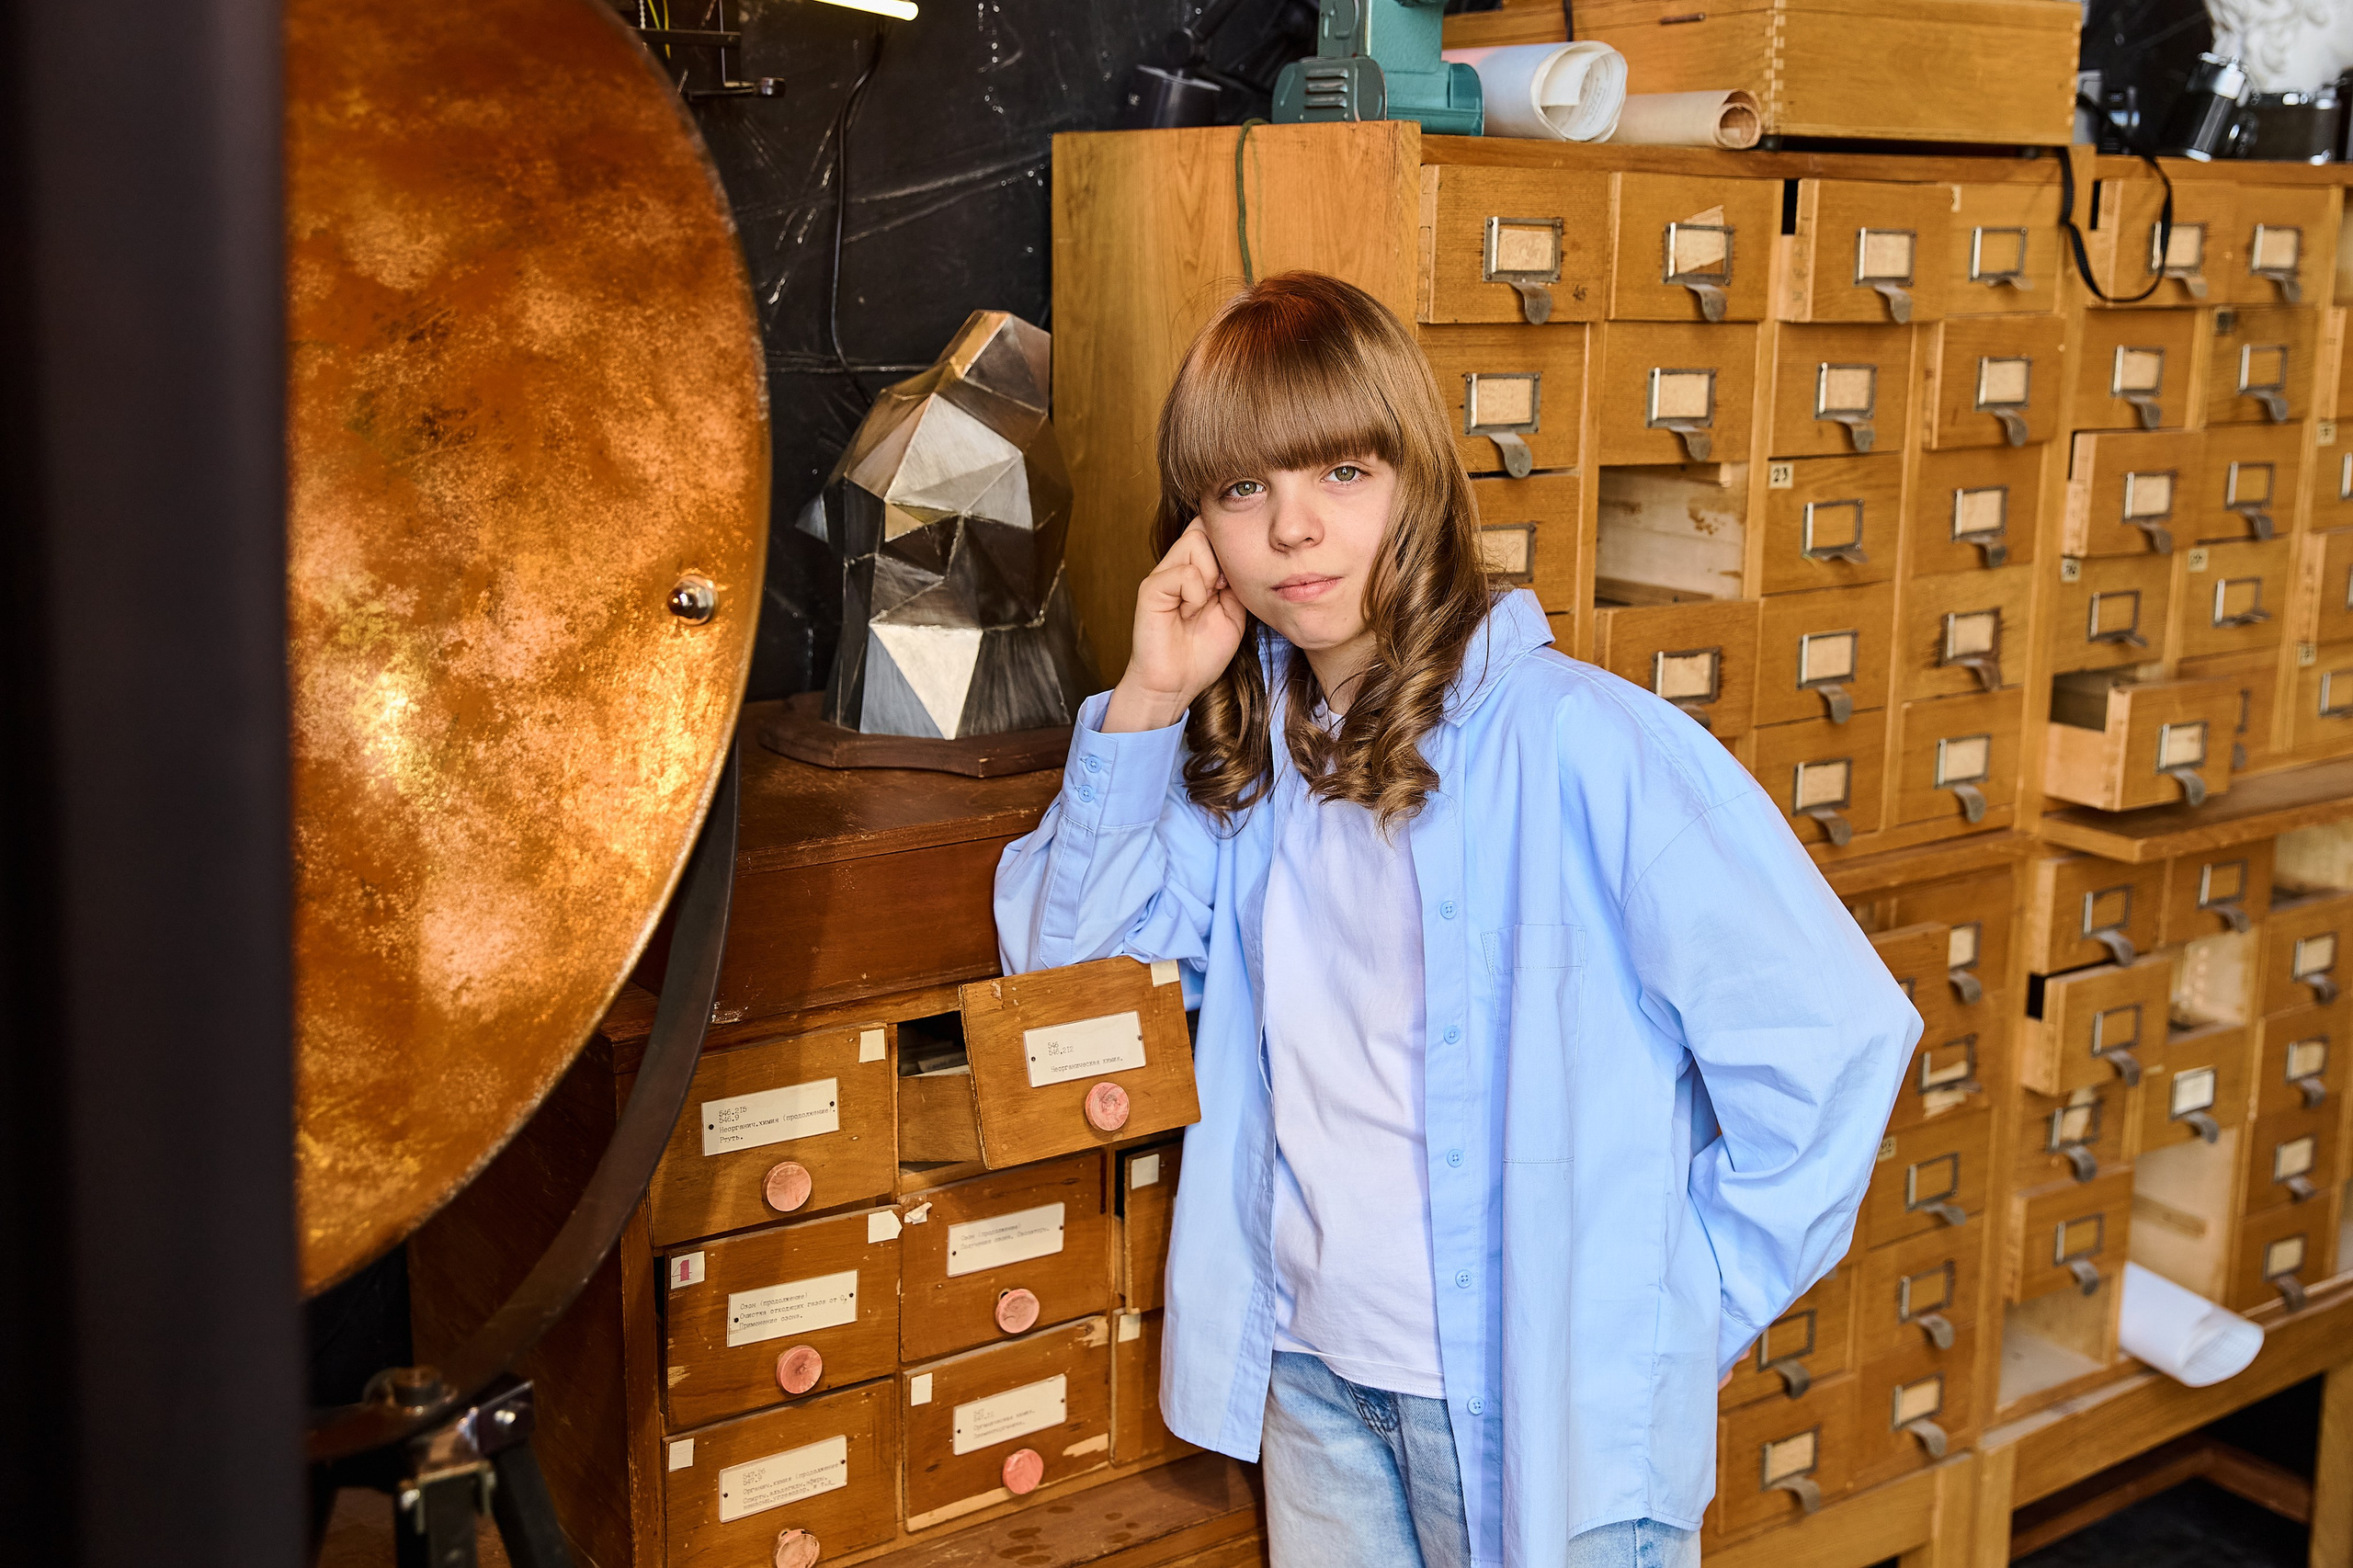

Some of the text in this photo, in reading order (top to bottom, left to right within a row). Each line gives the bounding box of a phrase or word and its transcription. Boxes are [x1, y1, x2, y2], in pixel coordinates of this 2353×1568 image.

[1051, 1060, 1100, 1073] Неорганическая
[720, 1135, 744, 1143] Ртуть.
[740, 1292, 808, 1311] Озон (продолжение)
[739, 1310, 767, 1320] Очистка
[770, 1303, 804, 1314] отходящих
[807, 1300, 826, 1308] газов
[739, 1314, 802, 1330] Применение озона.
